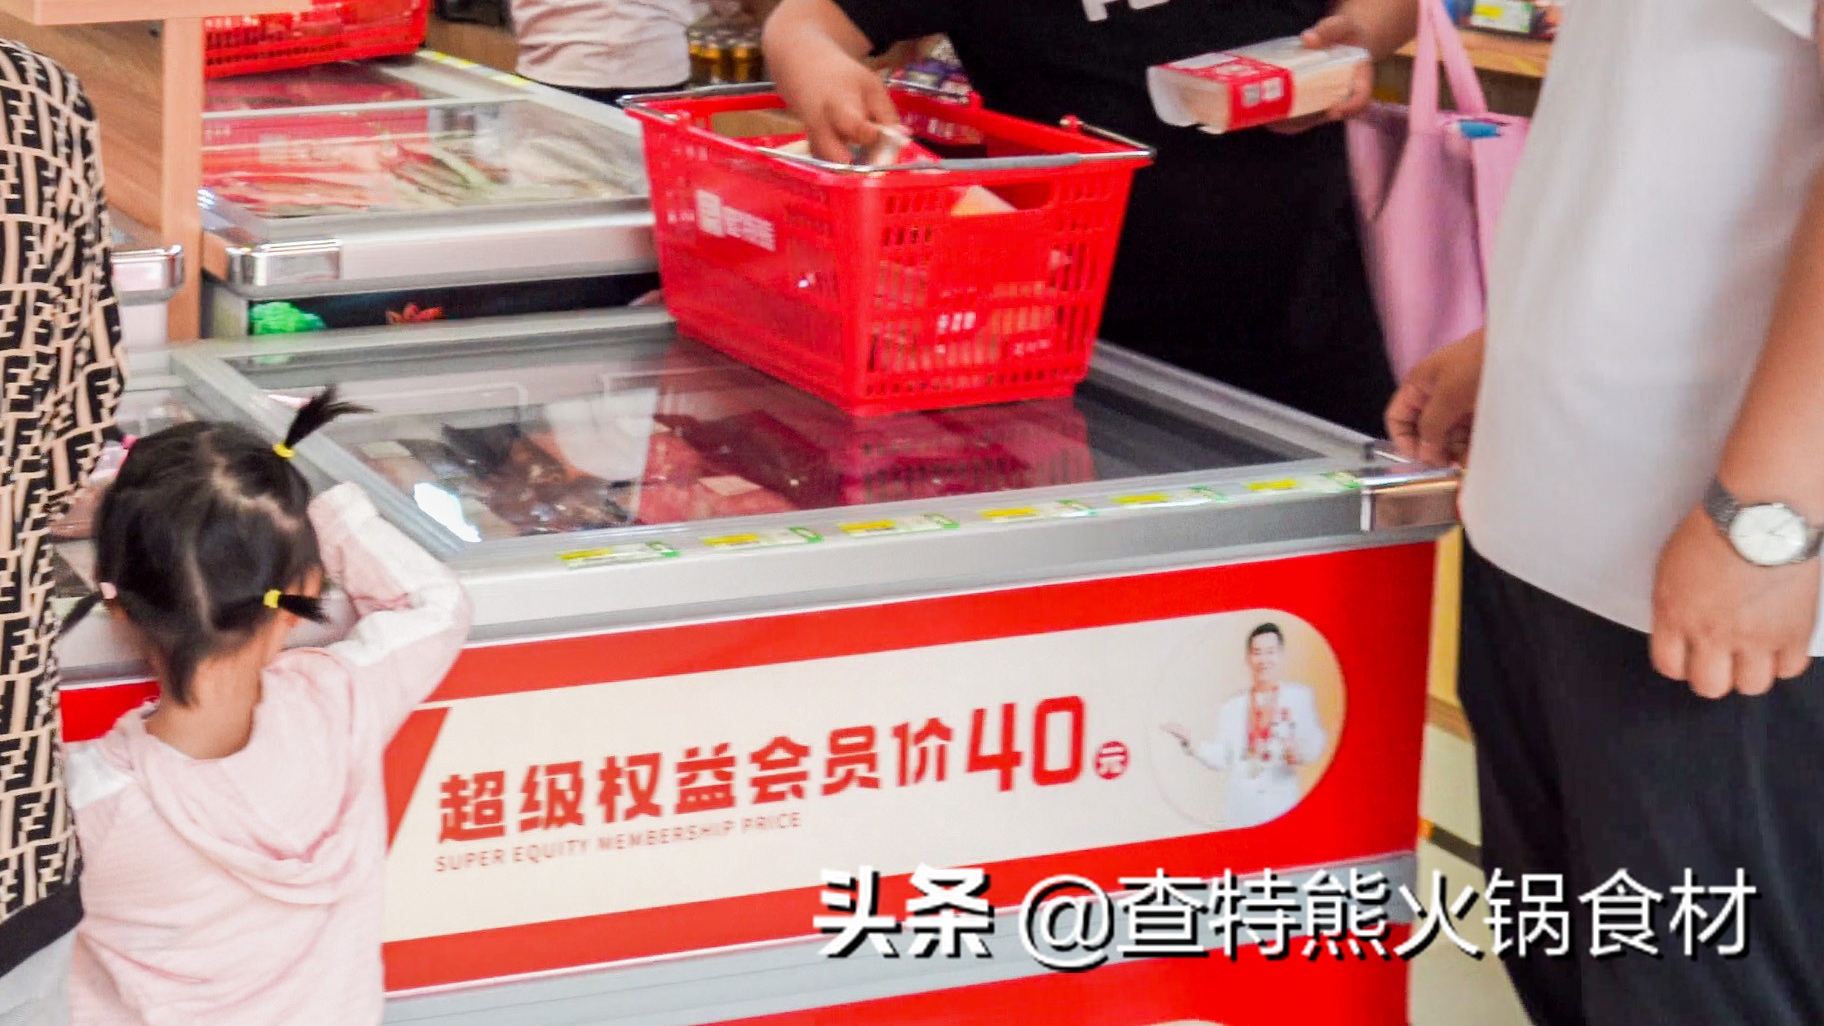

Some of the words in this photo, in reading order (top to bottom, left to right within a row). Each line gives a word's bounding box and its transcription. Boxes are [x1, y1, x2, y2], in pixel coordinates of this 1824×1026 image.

[435, 848, 506, 873] SUPER
[512, 838, 589, 864] EQUITY
[596, 820, 736, 851] MEMBERSHIP
[740, 811, 802, 835] PRICE
